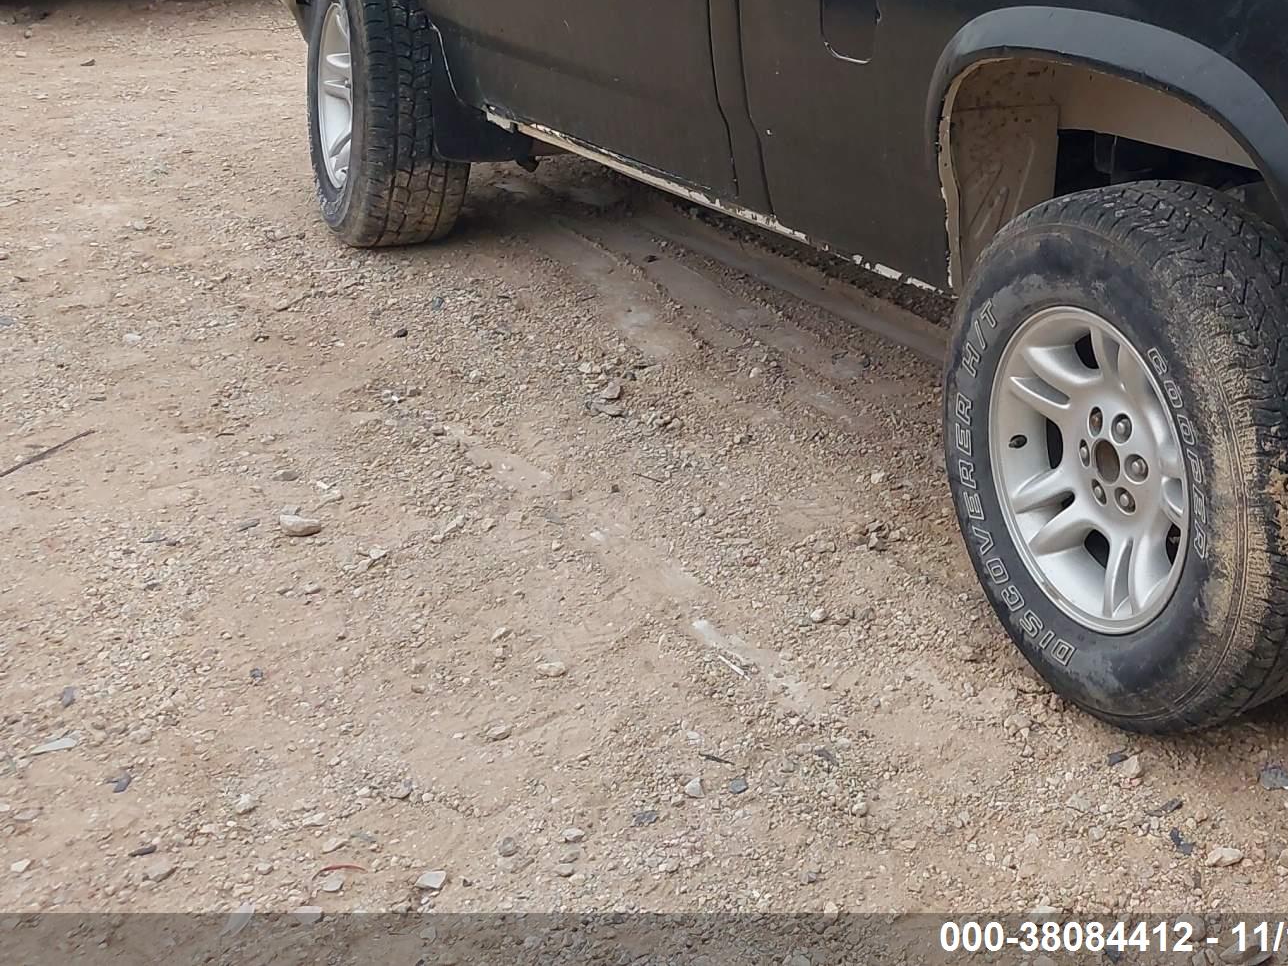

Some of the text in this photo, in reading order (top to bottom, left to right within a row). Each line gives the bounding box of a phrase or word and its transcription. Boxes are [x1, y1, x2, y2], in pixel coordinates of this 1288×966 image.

[955, 299, 1077, 668] DISCOVERER H/T
[1147, 347, 1208, 560] COOPER
